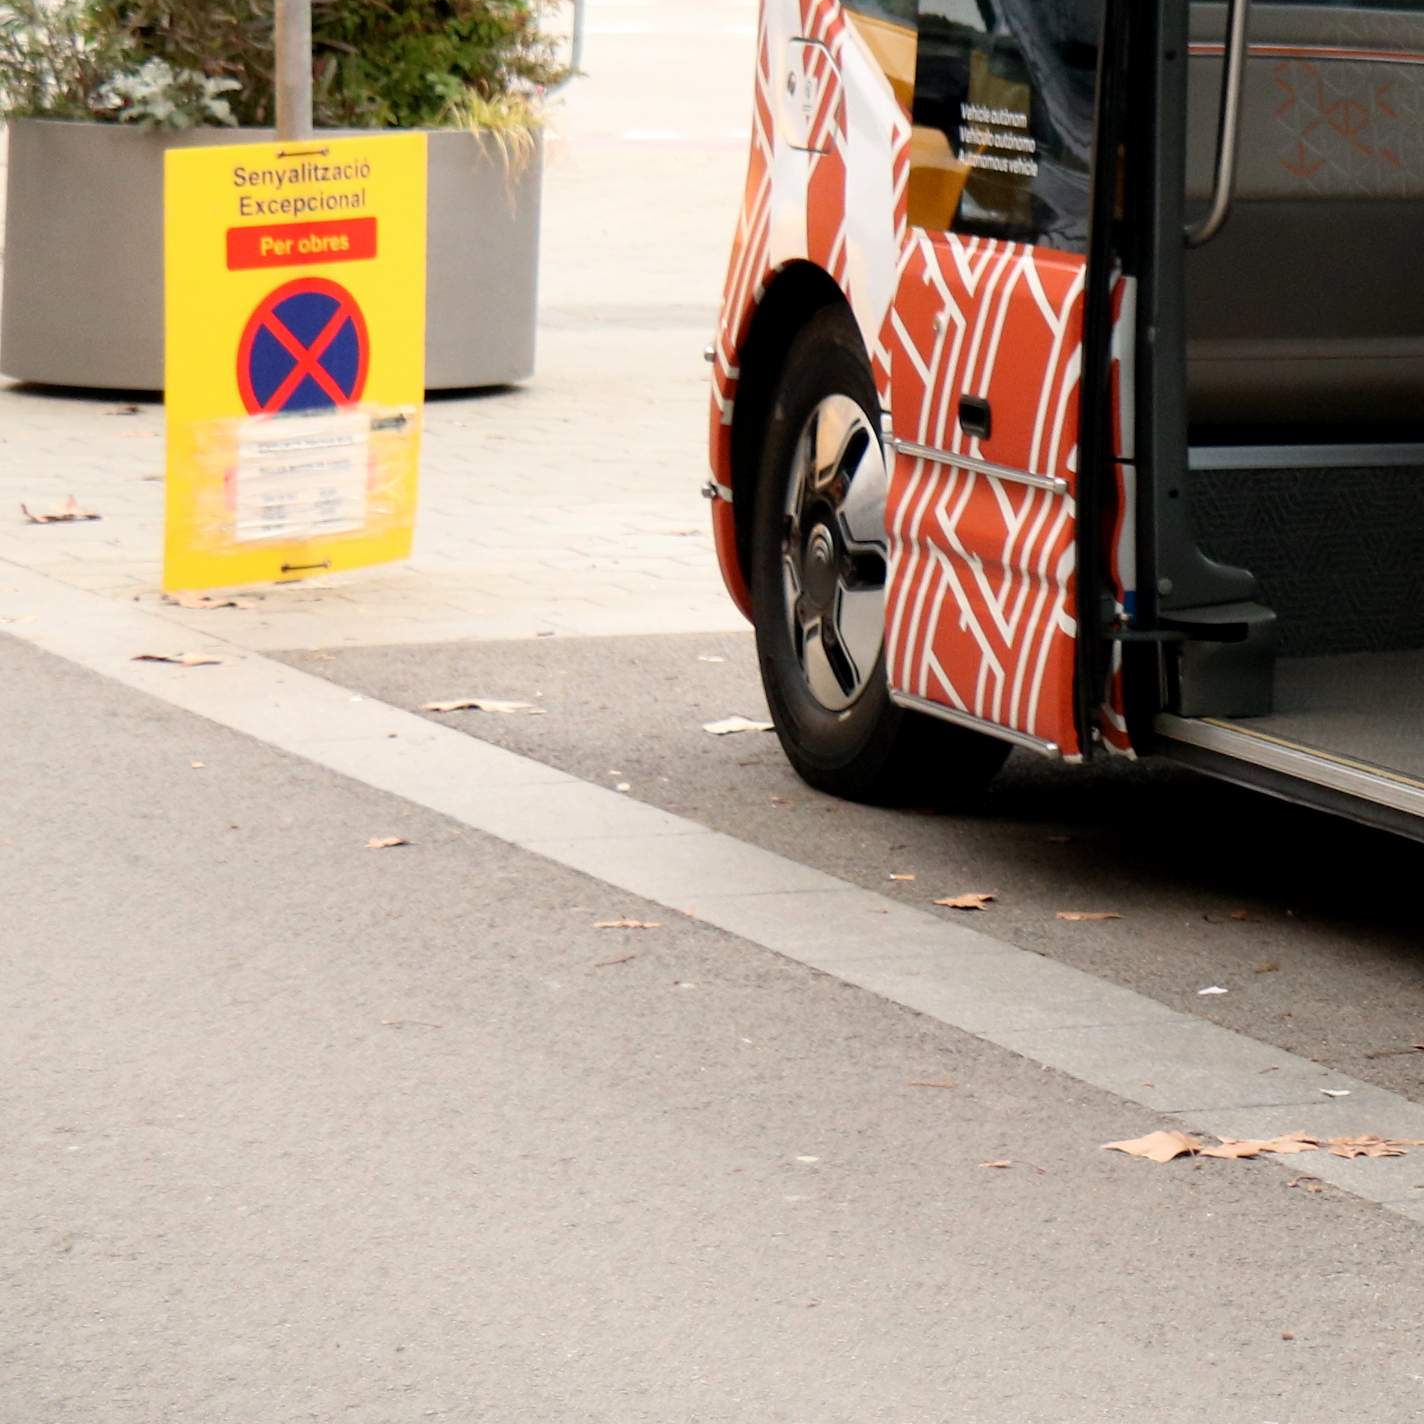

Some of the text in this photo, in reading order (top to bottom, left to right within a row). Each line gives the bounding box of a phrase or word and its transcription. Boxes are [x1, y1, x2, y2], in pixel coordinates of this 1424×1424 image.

[233, 157, 371, 189] Senyalització
[239, 188, 367, 218] Excepcional
[260, 232, 350, 257] Per obres
